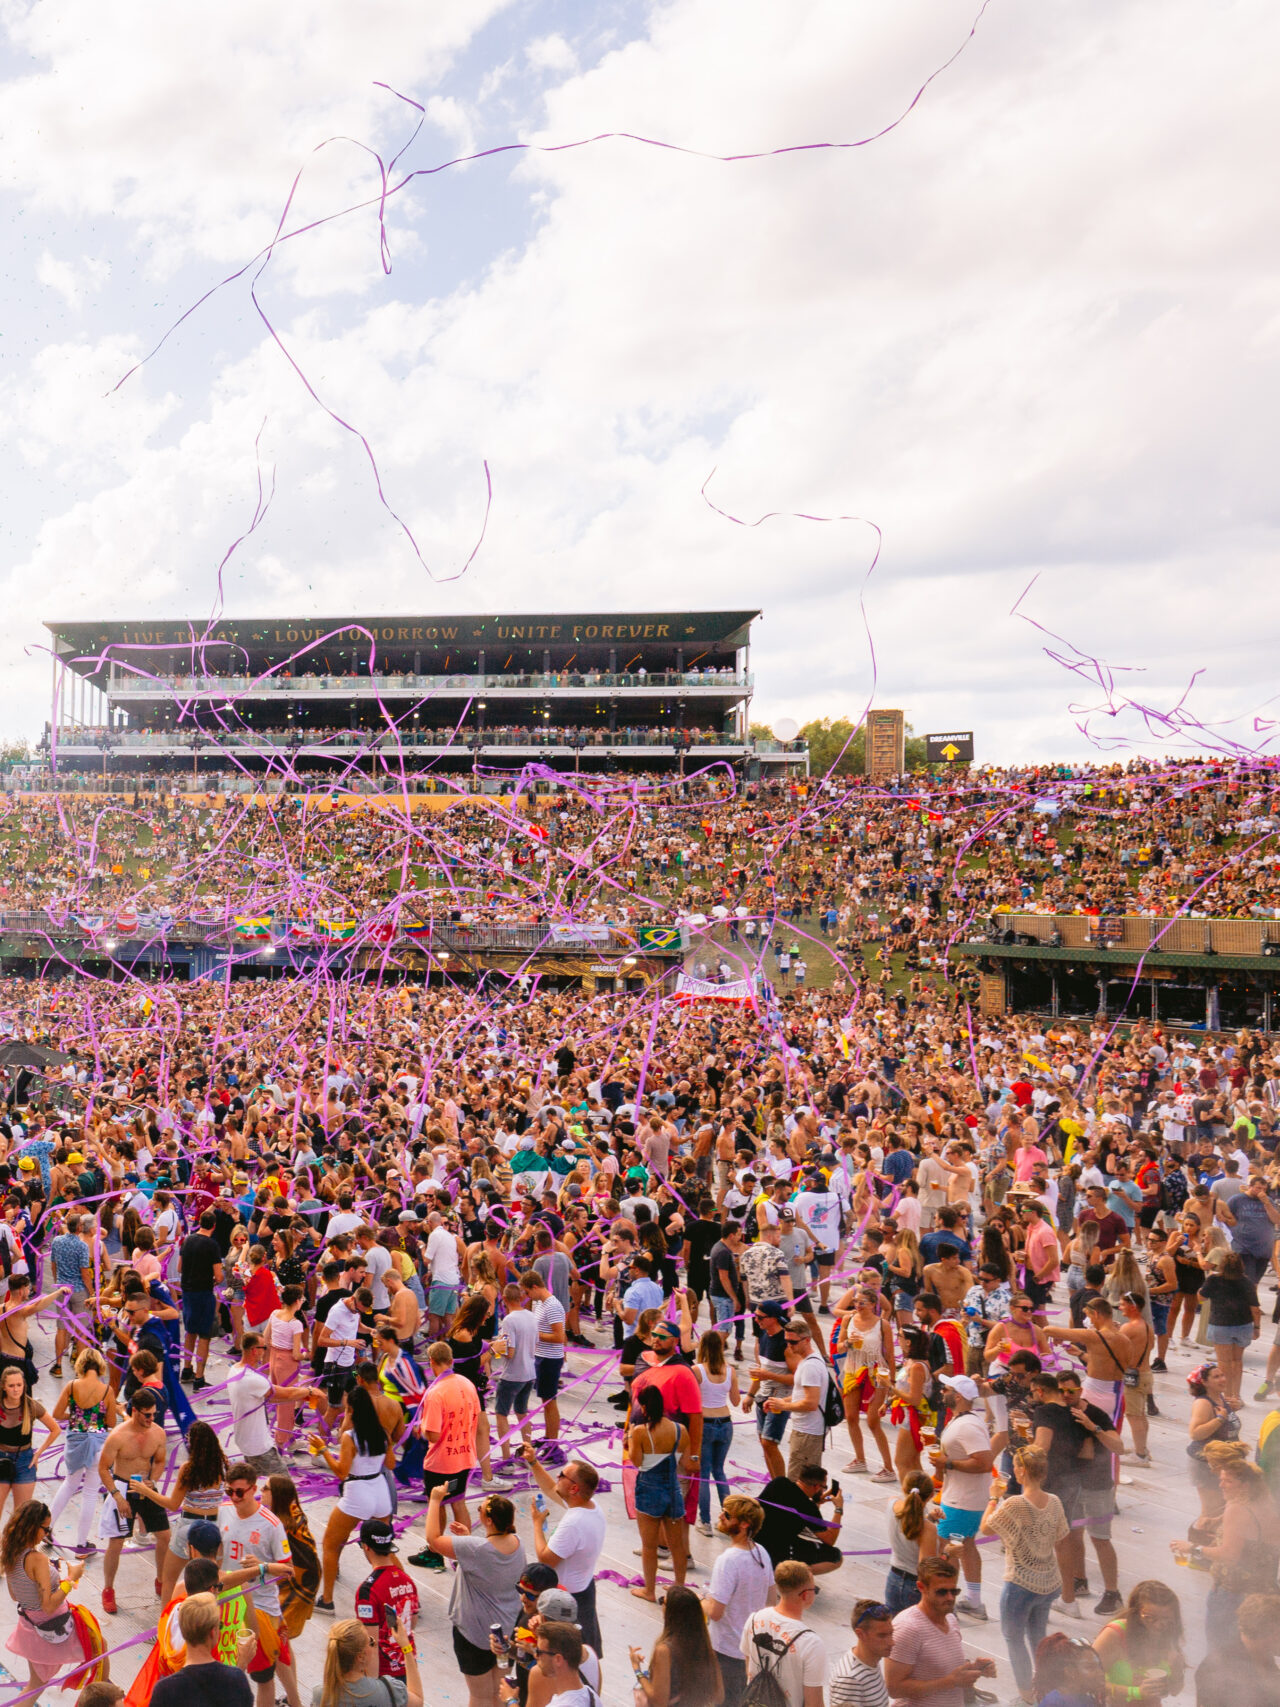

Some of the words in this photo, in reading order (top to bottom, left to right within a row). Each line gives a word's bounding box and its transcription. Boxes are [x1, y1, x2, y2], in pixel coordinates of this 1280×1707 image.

[123, 631, 166, 644] LIVE
[274, 629, 326, 643] LOVE
[337, 626, 460, 641] TOMORROW
[497, 625, 562, 639] UNITE
[572, 624, 671, 639] FOREVER
[929, 733, 971, 743] DREAMVILLE
